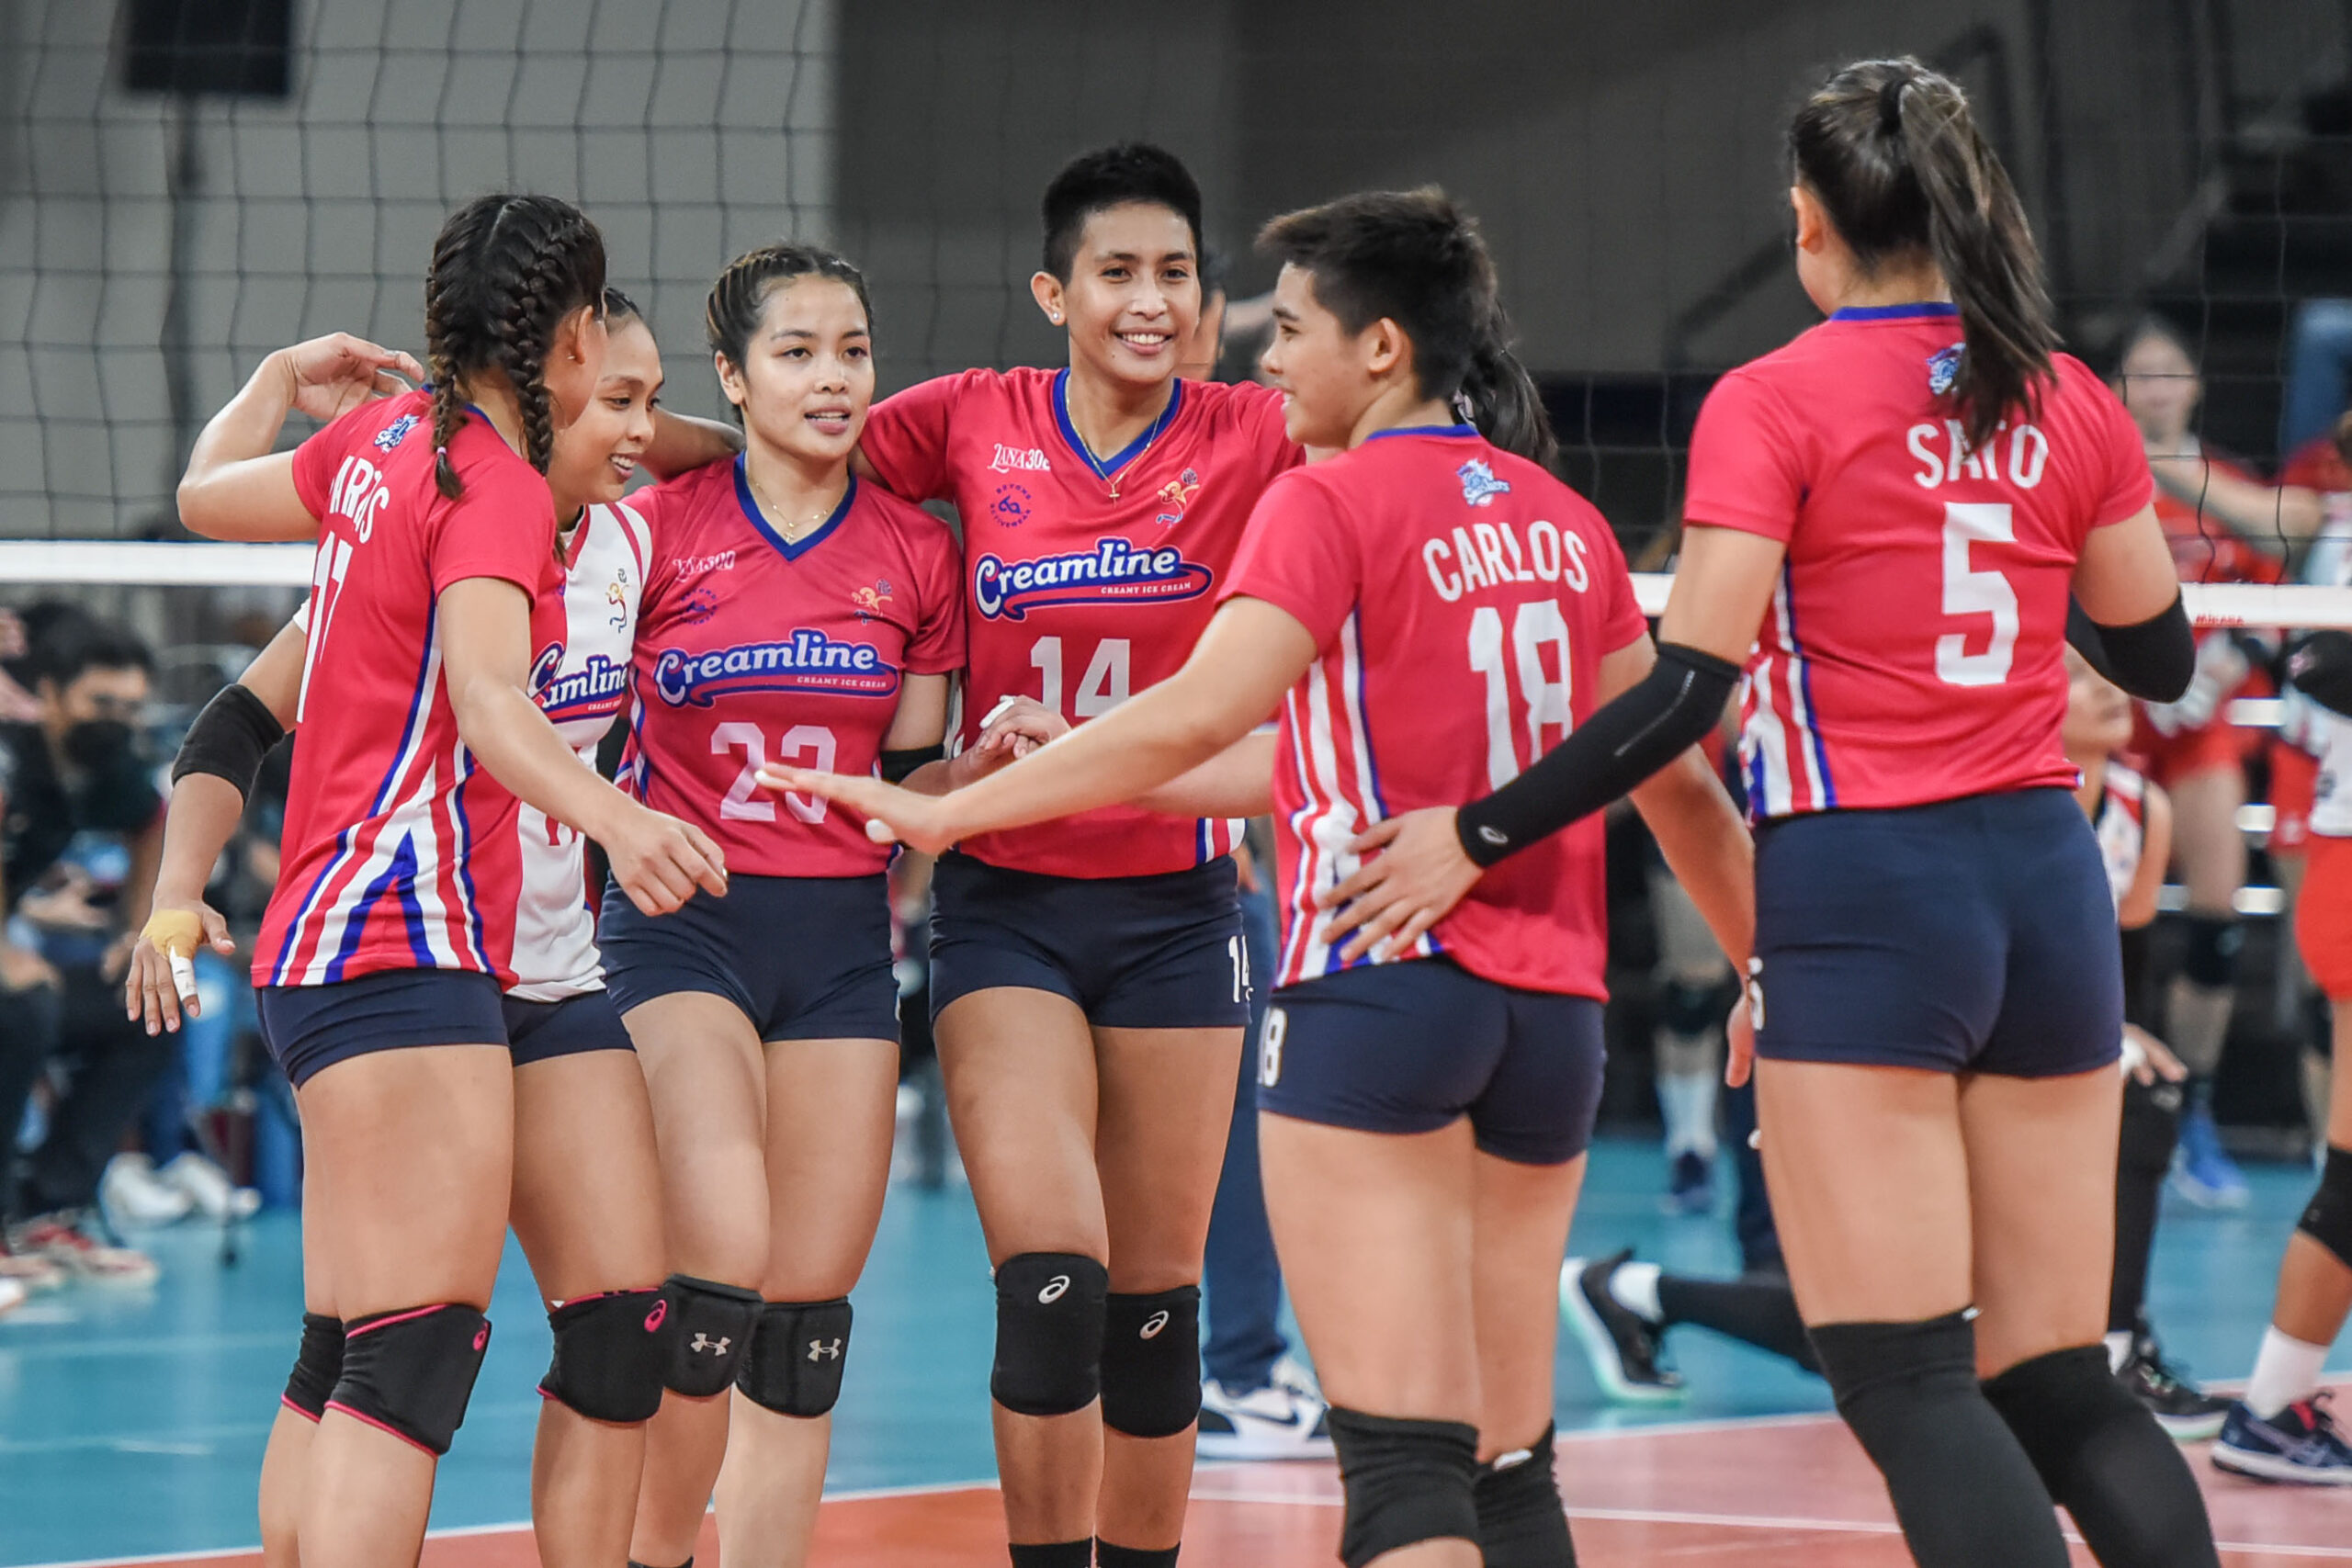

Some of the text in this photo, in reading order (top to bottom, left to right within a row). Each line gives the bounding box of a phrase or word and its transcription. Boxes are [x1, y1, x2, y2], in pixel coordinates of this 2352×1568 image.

[975, 542, 1177, 615] Creamline
[1101, 581, 1192, 594] CREAMY ICE CREAM
[1423, 520, 1589, 603] CARLOS
[1935, 501, 2018, 686] 5
[654, 632, 876, 705] Creamline
[797, 676, 838, 685] CREAMY
[841, 679, 858, 687] ICE
[1030, 636, 1131, 717] 14
[710, 721, 837, 825] 23
